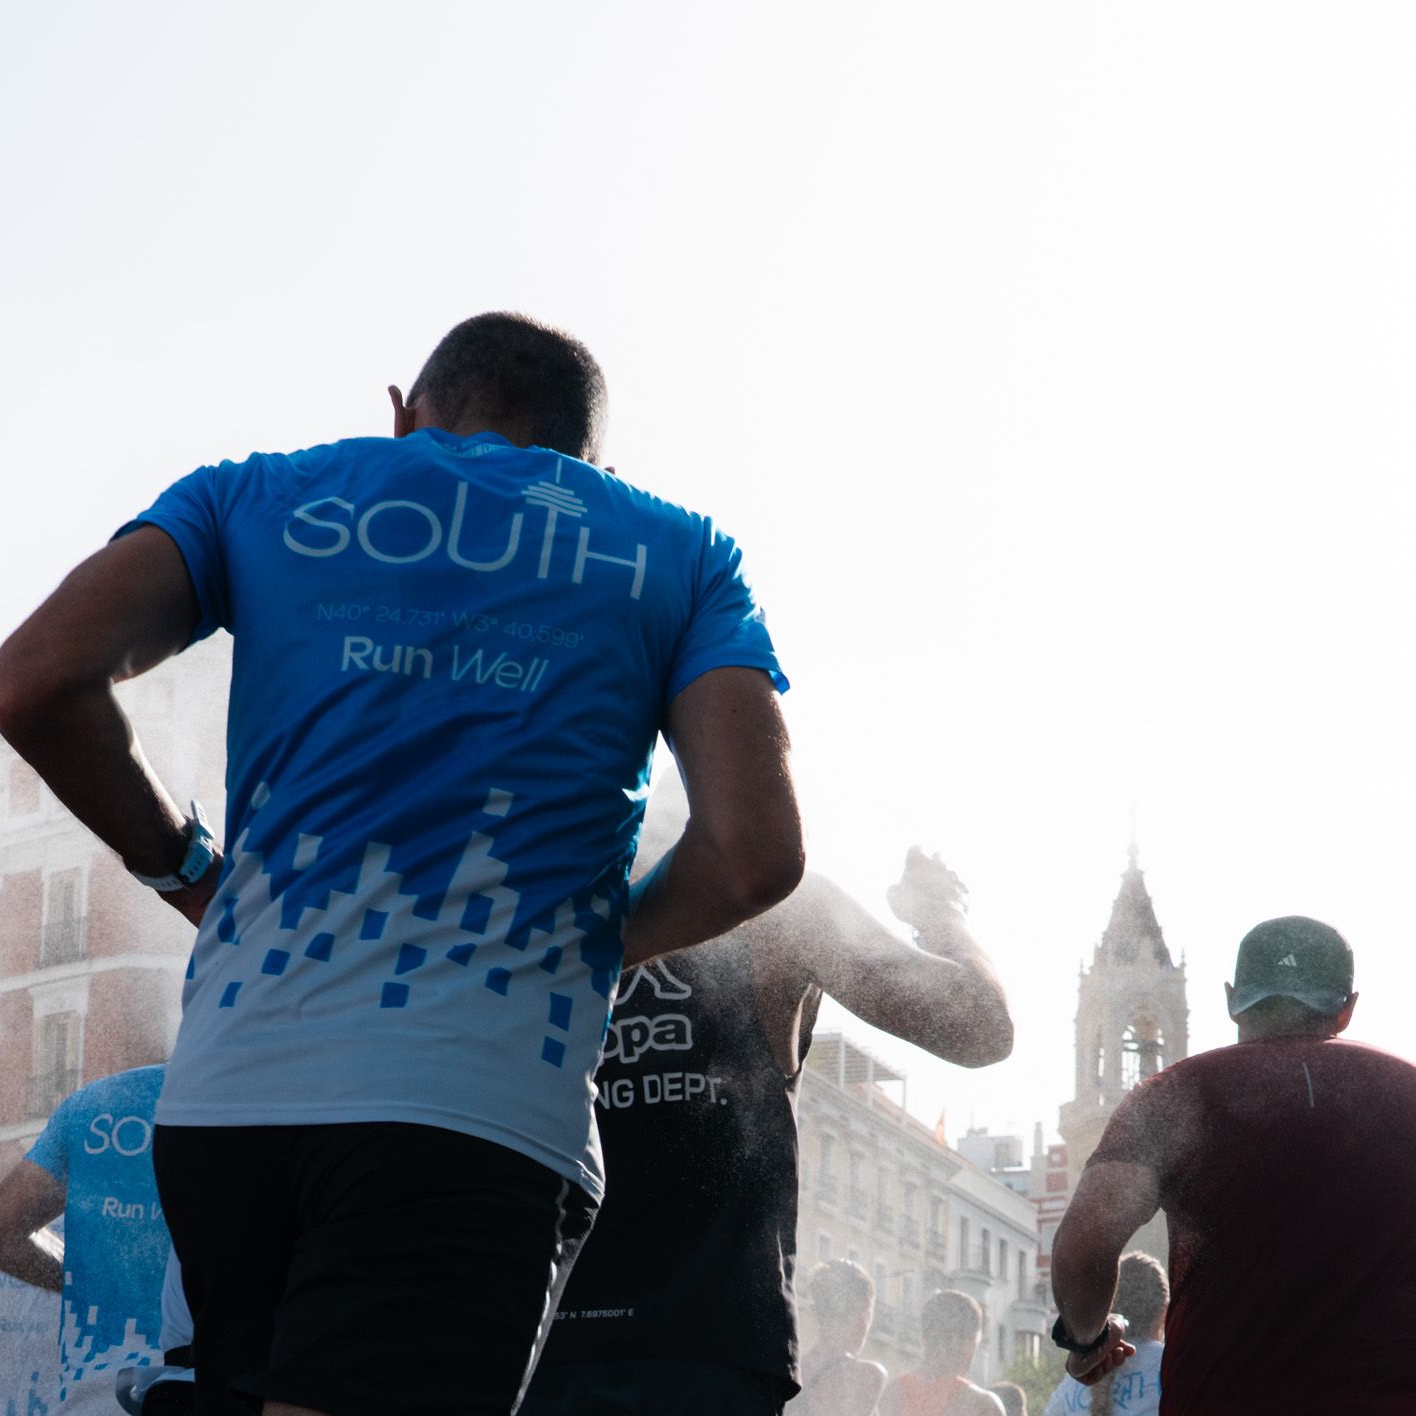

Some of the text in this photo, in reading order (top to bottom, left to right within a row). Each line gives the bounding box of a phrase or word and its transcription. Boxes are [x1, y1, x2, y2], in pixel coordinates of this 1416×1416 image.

[283, 468, 647, 600] SOUTH
[340, 635, 549, 692] Run Well
[642, 1071, 728, 1106] DEPT.
[102, 1196, 144, 1219] Run
